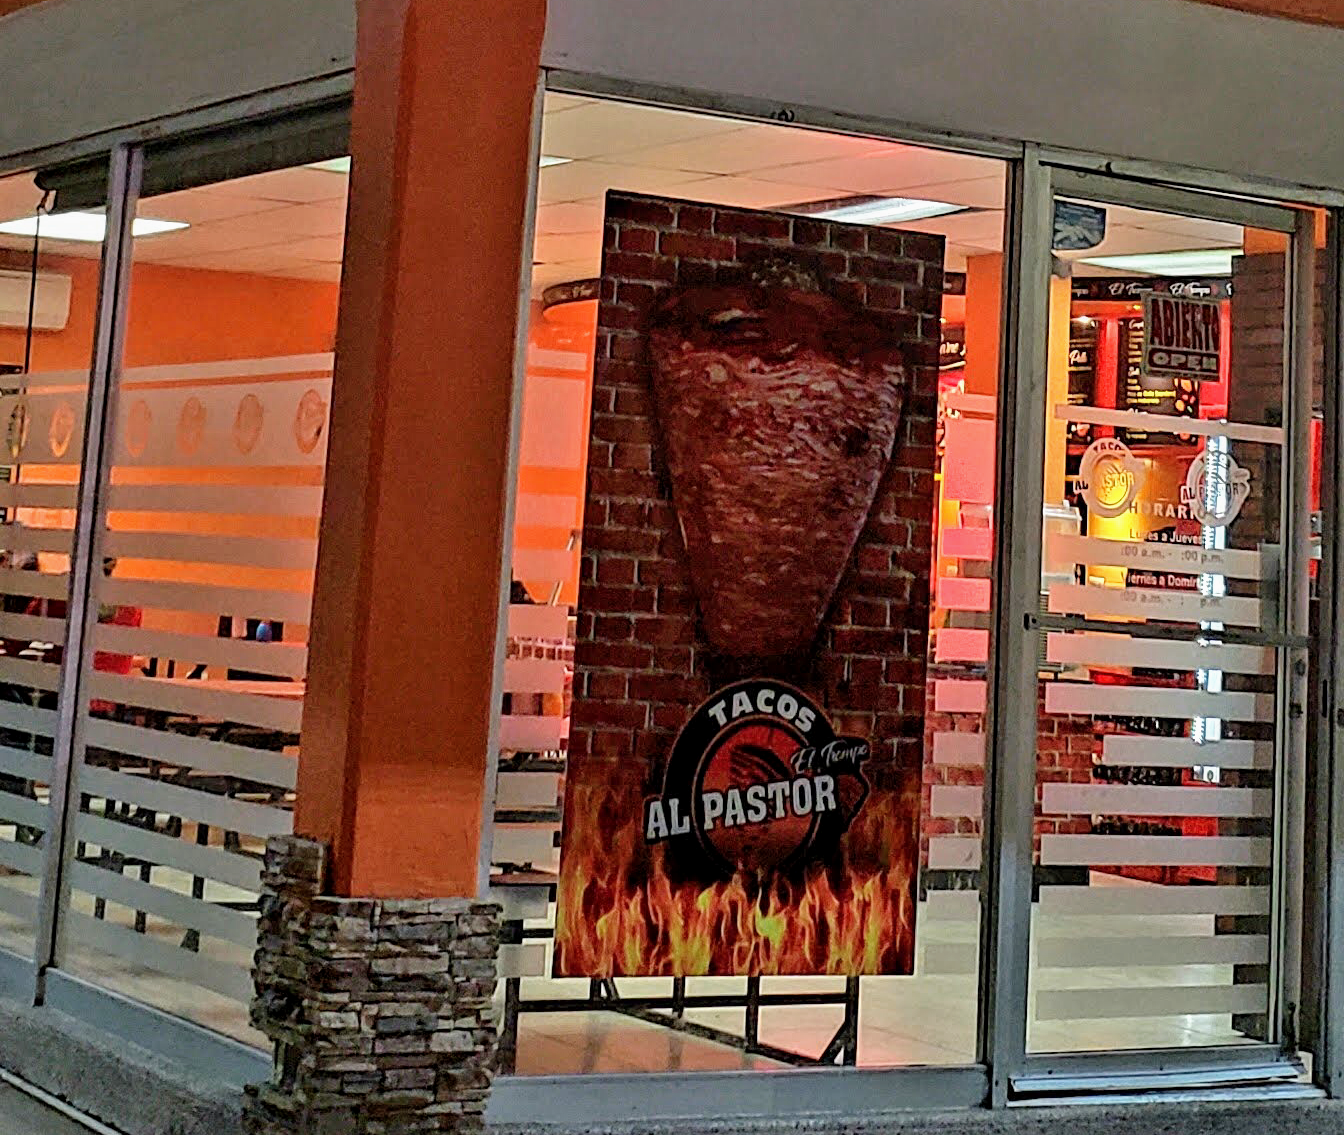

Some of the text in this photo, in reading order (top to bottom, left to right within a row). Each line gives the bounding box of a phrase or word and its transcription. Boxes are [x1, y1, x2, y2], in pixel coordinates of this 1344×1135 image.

[1150, 298, 1220, 352] ABIERTO
[1152, 351, 1218, 370] OPEN
[1129, 501, 1197, 520] HORARI
[1170, 531, 1203, 545] Jueves
[708, 689, 816, 733] TACOS
[790, 739, 868, 774] El Trompo
[645, 774, 837, 840] AL PASTOR
